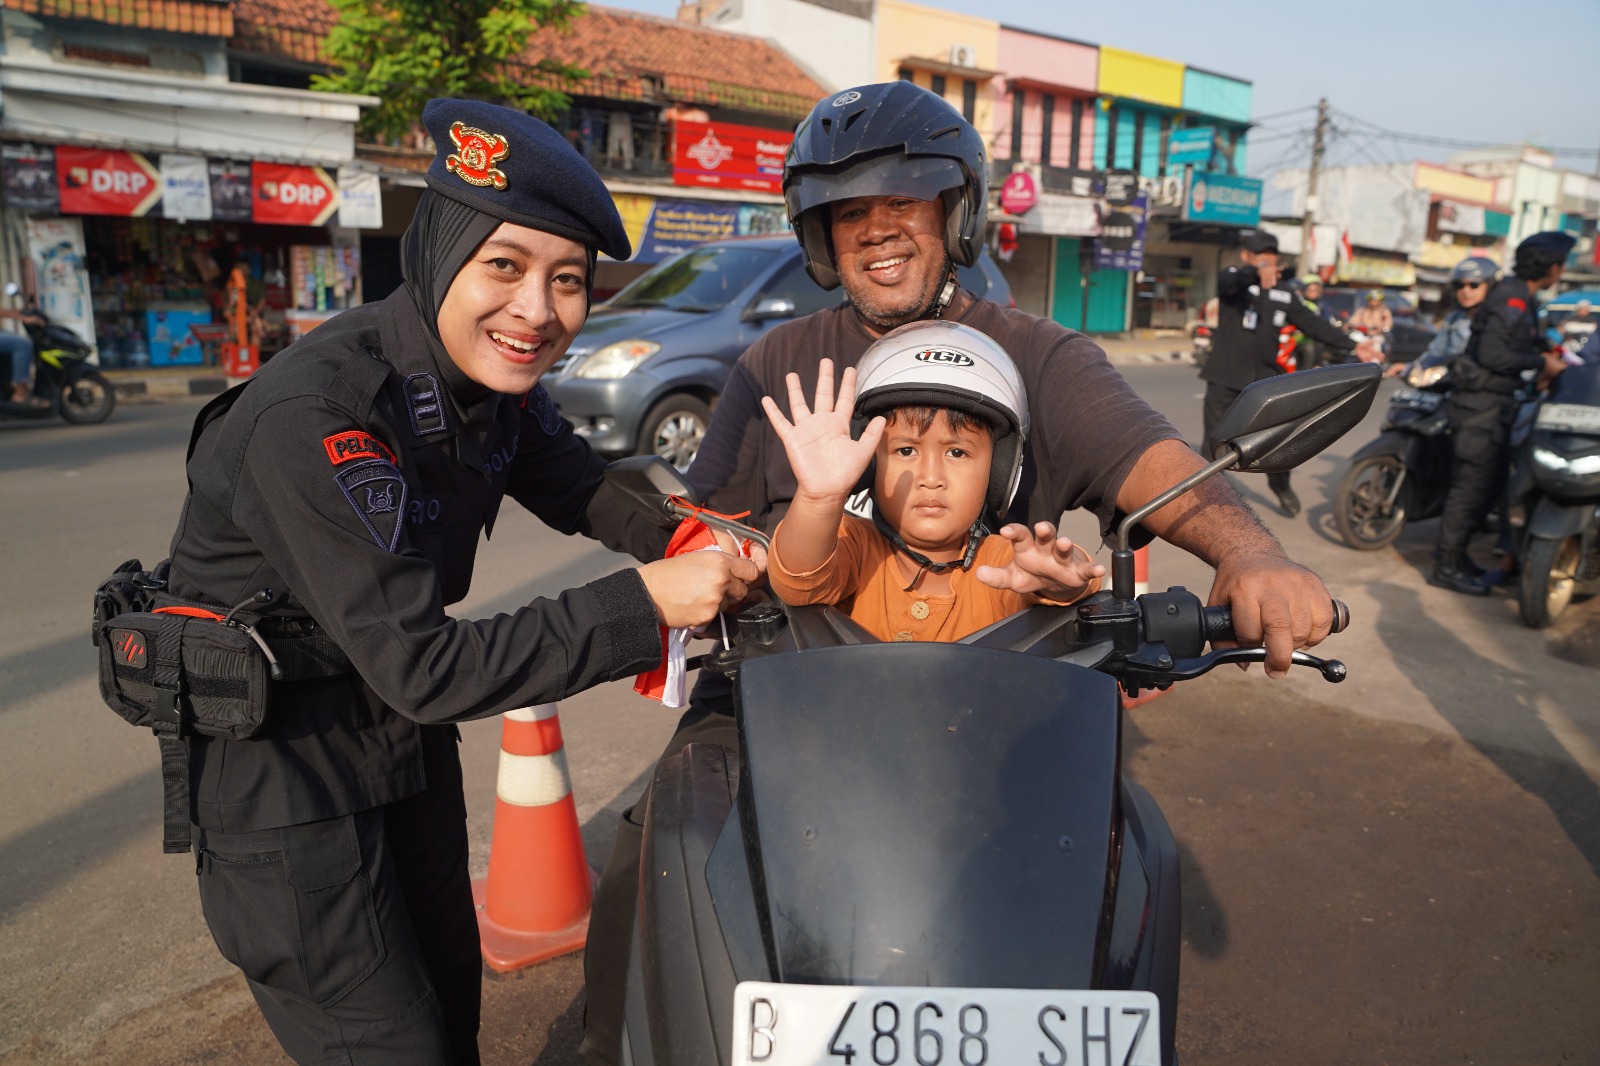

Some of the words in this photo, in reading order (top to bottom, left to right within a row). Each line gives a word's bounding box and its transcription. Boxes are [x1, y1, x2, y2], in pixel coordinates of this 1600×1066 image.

[92, 168, 148, 195] DRP
[279, 183, 327, 206] DRP
[346, 467, 374, 485] KORPS
[751, 997, 777, 1062] B
[827, 1000, 988, 1066] 4868
[1037, 1004, 1150, 1066] SHZ
